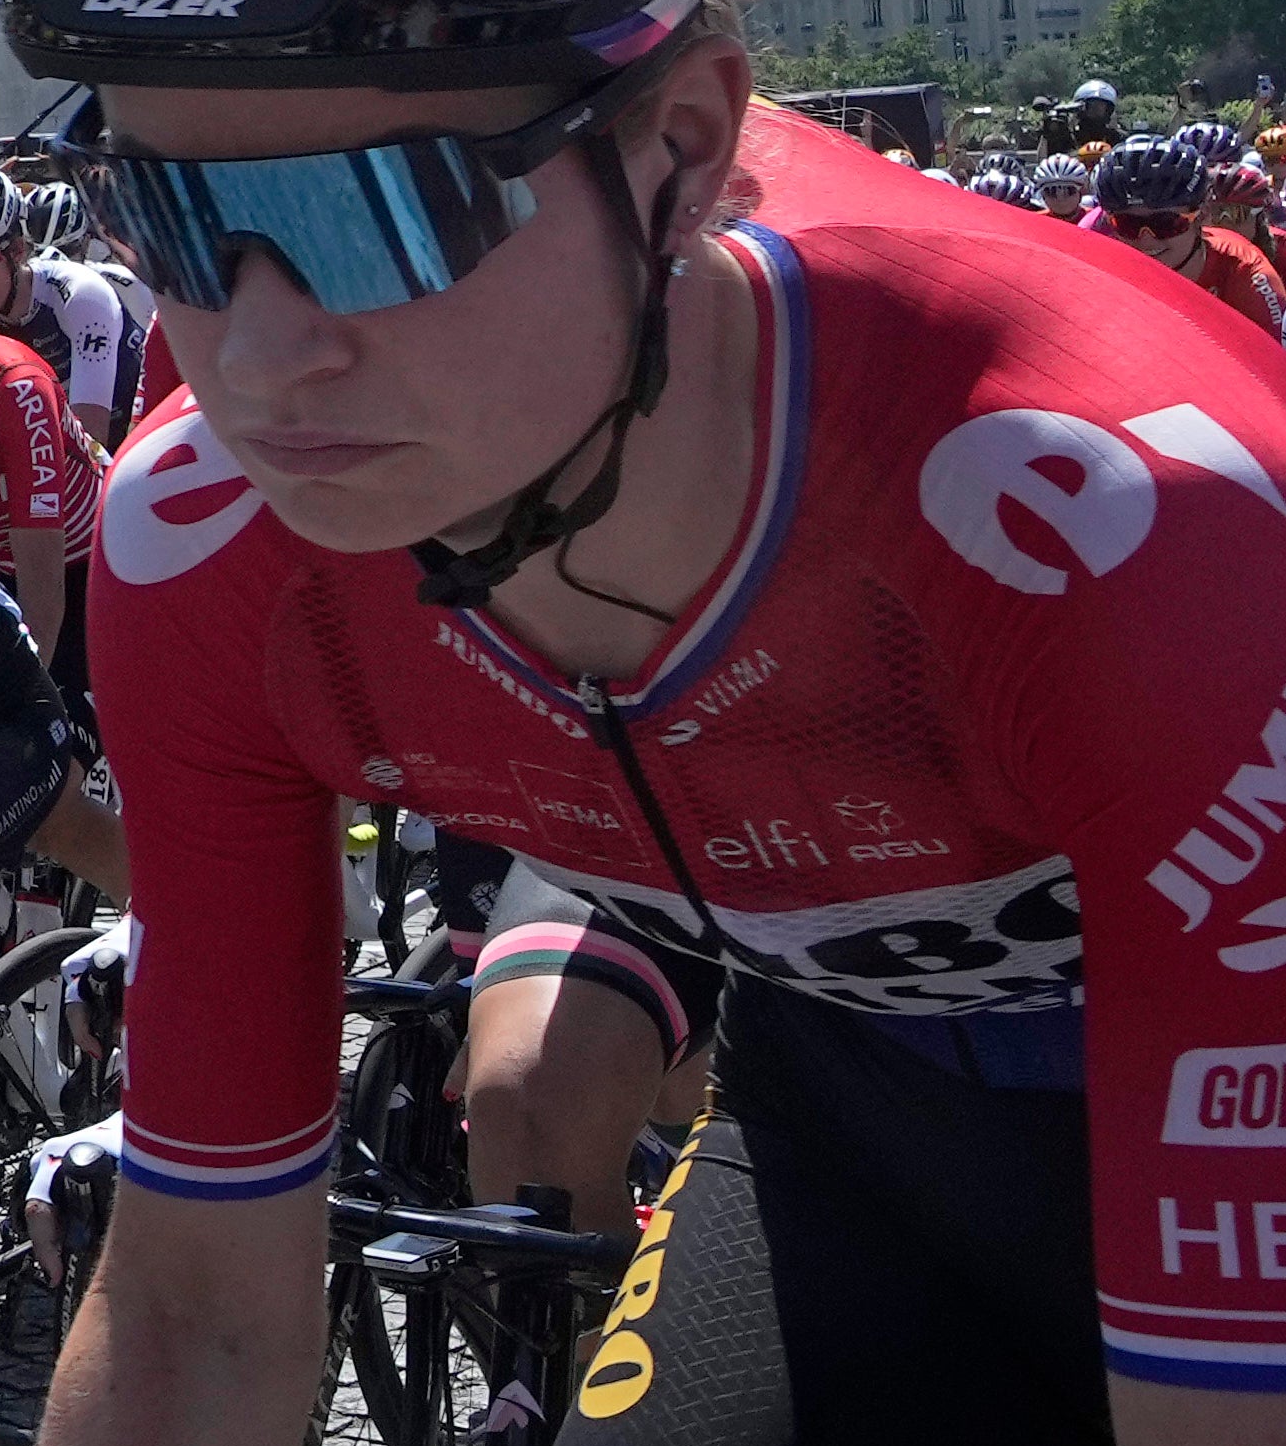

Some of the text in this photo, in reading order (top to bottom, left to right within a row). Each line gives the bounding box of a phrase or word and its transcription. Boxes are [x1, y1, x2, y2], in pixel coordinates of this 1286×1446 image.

[6, 378, 57, 487] ARKEA
[432, 620, 590, 740] JUMBO
[694, 648, 783, 717] VISMA
[87, 766, 109, 799] 18
[533, 796, 623, 831] HEMA
[1145, 687, 1286, 934] JUM
[702, 817, 829, 872] elfi
[847, 837, 952, 864] AGU
[1196, 1060, 1286, 1131] GO
